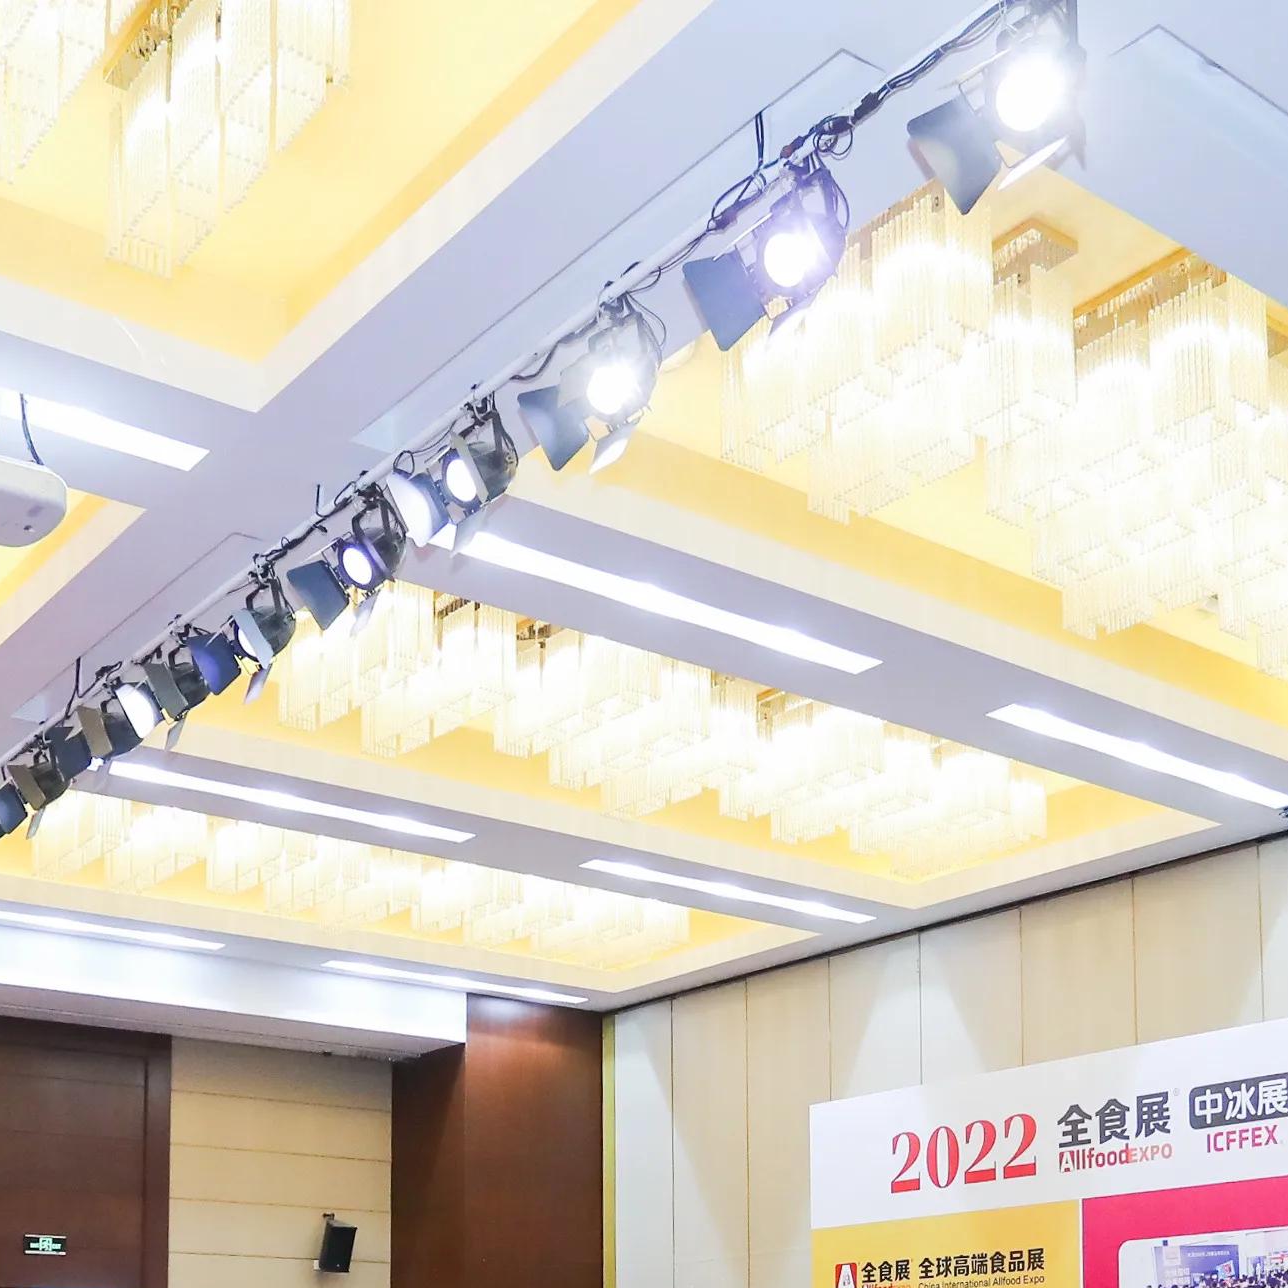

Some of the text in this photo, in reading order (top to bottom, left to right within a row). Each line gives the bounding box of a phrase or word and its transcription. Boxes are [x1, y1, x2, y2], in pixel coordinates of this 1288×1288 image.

[1057, 1090, 1172, 1149] 全食展
[890, 1112, 1038, 1194] 2022
[1206, 1124, 1279, 1153] ICFFEX
[861, 1247, 1045, 1284] 全食展 全球高端食品展
[942, 1278, 991, 1288] International
[992, 1275, 1021, 1287] Allfood
[1023, 1274, 1045, 1285] Expo
